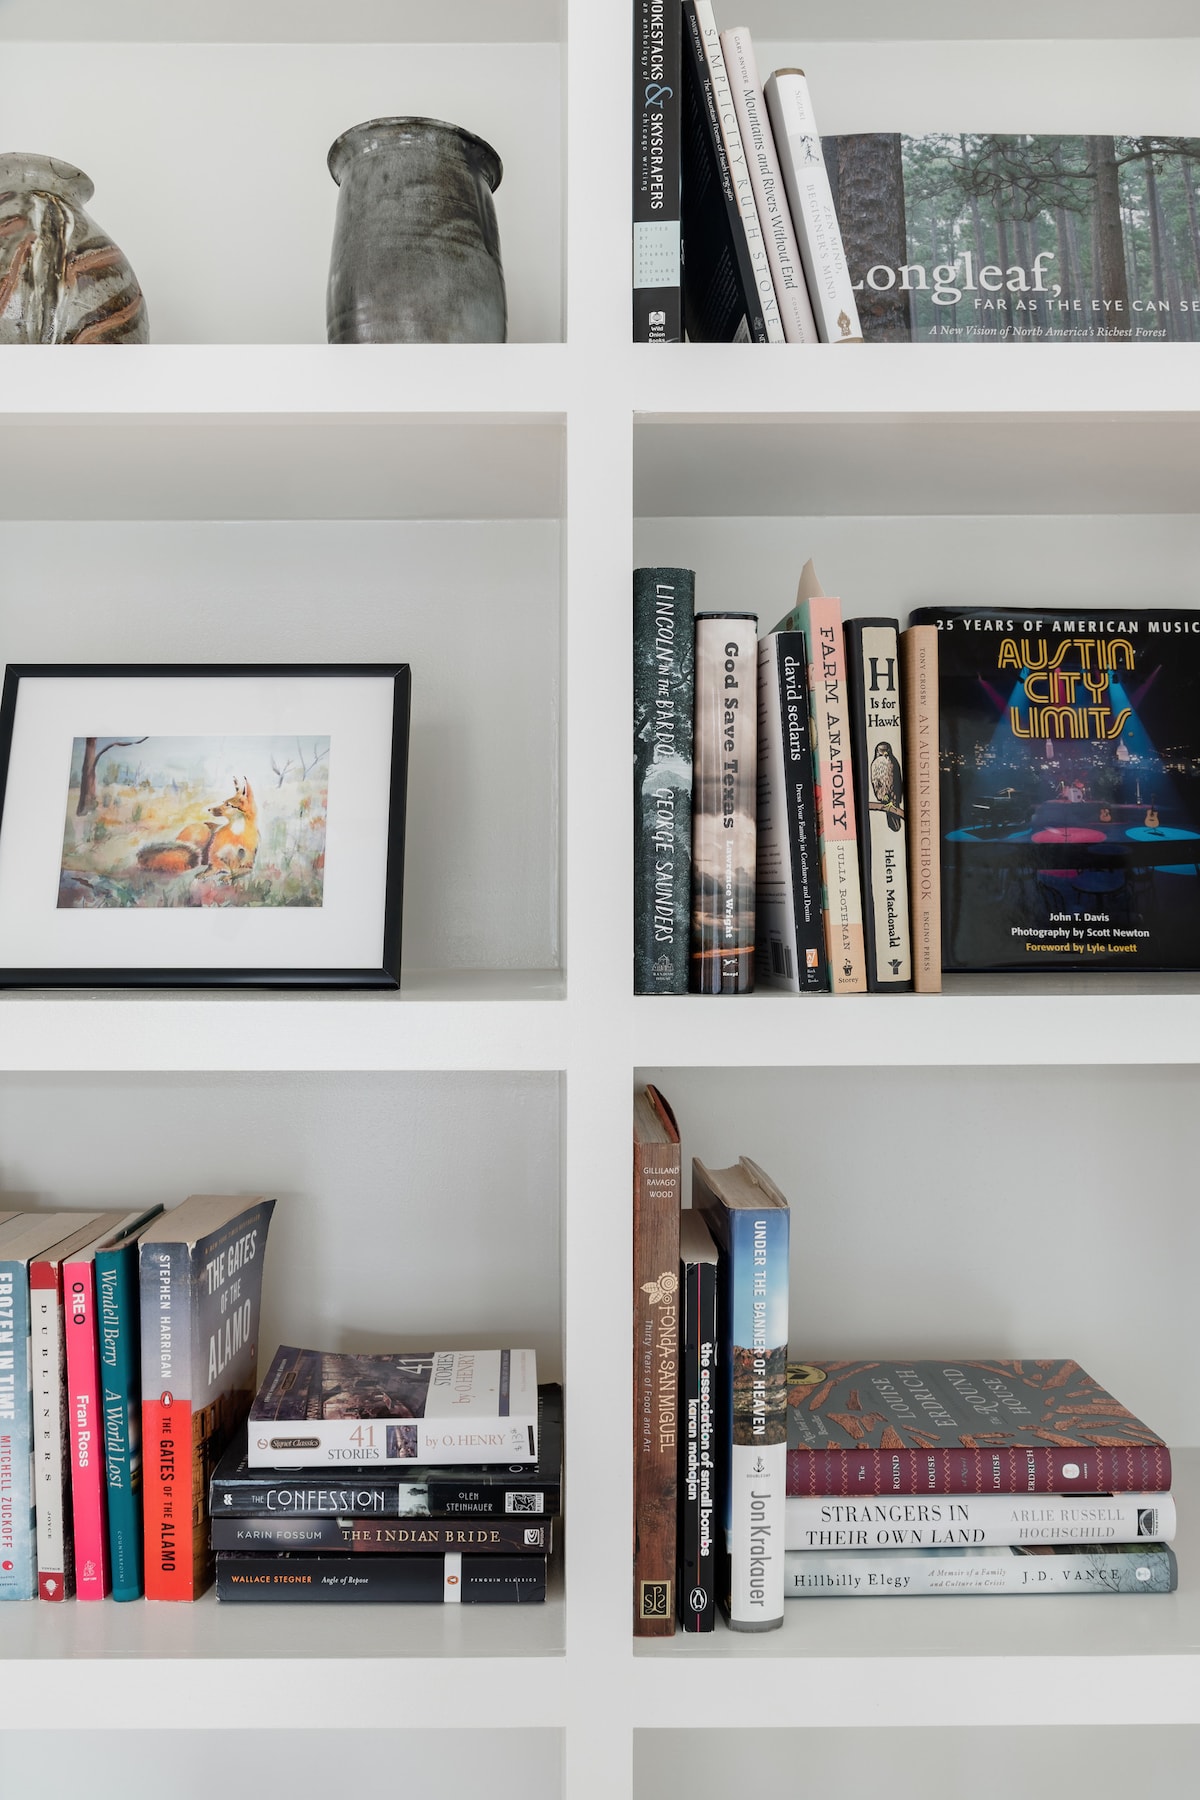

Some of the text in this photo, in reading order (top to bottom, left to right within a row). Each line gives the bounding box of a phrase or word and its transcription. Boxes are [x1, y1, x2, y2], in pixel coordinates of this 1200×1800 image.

[641, 3, 650, 191] an anthology of chicago writing
[645, 83, 673, 109] &
[651, 113, 663, 209] SKYSCRAPERS
[705, 29, 745, 165] SIMPLICITY
[737, 179, 760, 240] RUTH
[753, 252, 779, 327] STONE
[974, 299, 1008, 310] FAR
[1015, 299, 1038, 310] AS
[1045, 300, 1082, 311] THE
[1091, 300, 1124, 311] EYE
[1132, 300, 1170, 312] CAN
[928, 325, 938, 335] A
[939, 325, 963, 335] New
[964, 325, 997, 335] Vision
[999, 325, 1014, 339] of
[1012, 326, 1043, 337] North
[1096, 327, 1133, 337] Richest
[1135, 327, 1167, 337] Forest
[936, 619, 1200, 633] 25 YEARS OF AMERICAN MUSIC
[655, 583, 675, 755] LINCOLN IN THE BARDO
[998, 638, 1135, 671] AUSTIN
[869, 657, 896, 692] H
[919, 673, 927, 706] CROSBY
[1024, 671, 1109, 704] CITY
[784, 656, 806, 761] david sedaris
[868, 714, 900, 728] Hawk
[919, 714, 929, 735] AN
[1010, 706, 1132, 739] LIMITS
[723, 642, 739, 829] God Save Texas
[820, 627, 847, 830] FARM ANATOMY
[919, 740, 930, 795] AUSTIN
[651, 787, 675, 944] GEORGE SAUNDERS
[920, 799, 932, 900] SKETCHBOOK
[724, 839, 735, 938] Lawrence Wright
[837, 845, 851, 950] JULIA ROTHMAN
[884, 849, 901, 948] Helen Macdonald
[1011, 927, 1150, 939] Photography by Scott Newton
[1049, 912, 1110, 922] John T. Davis
[1025, 943, 1137, 954] Foreword by Lyle Lovett
[643, 1167, 680, 1175] GILLILAND
[646, 1179, 676, 1187] RAVAGO
[206, 1251, 226, 1296] THE
[227, 1229, 258, 1278] GATES
[72, 1282, 86, 1325] OREO
[101, 1269, 120, 1367] Wendell Berry
[159, 1254, 172, 1378] STEPHEN HARRIGAN
[208, 1297, 251, 1386] ALAMO
[752, 1220, 767, 1435] UNDER THE BANNER OF HEAVEN
[41, 1305, 52, 1481] DUBLINERS
[642, 1319, 653, 1452] Thirty Years of Food and Art
[76, 1394, 91, 1467] Fran Ross
[105, 1389, 126, 1488] A World Lost
[349, 1425, 376, 1447] 41
[328, 1448, 380, 1460] STORIES
[686, 1398, 700, 1500] karan mahajan
[700, 1341, 713, 1557] the association of small bombs
[892, 1455, 900, 1490] ROUND
[927, 1455, 936, 1489] HOUSE
[992, 1449, 1036, 1491] LOUISE ERDRICH
[160, 1417, 176, 1572] THE GATES OF THE ALAMO
[252, 1490, 385, 1511] THE CONFESSION
[446, 1503, 493, 1512] STEINHAUER
[458, 1492, 479, 1501] OLEN
[750, 1491, 771, 1521] Jon
[821, 1504, 970, 1523] STRANGERS IN
[1010, 1508, 1125, 1522] ARLIE RUSSELL
[237, 1531, 322, 1539] KARIN FOSSUM
[342, 1530, 501, 1543] THE INDIAN BRIDE
[806, 1528, 986, 1546] THEIR OWN LAND
[1018, 1526, 1116, 1539] HOCHSCHILD
[117, 1530, 125, 1583] COUNTERPOINT
[750, 1525, 772, 1607] Krakauer
[231, 1575, 312, 1584] WALLACE STEGNER
[793, 1573, 911, 1589] Hillbilly Elegy
[1022, 1568, 1121, 1584] J.D. VANCE
